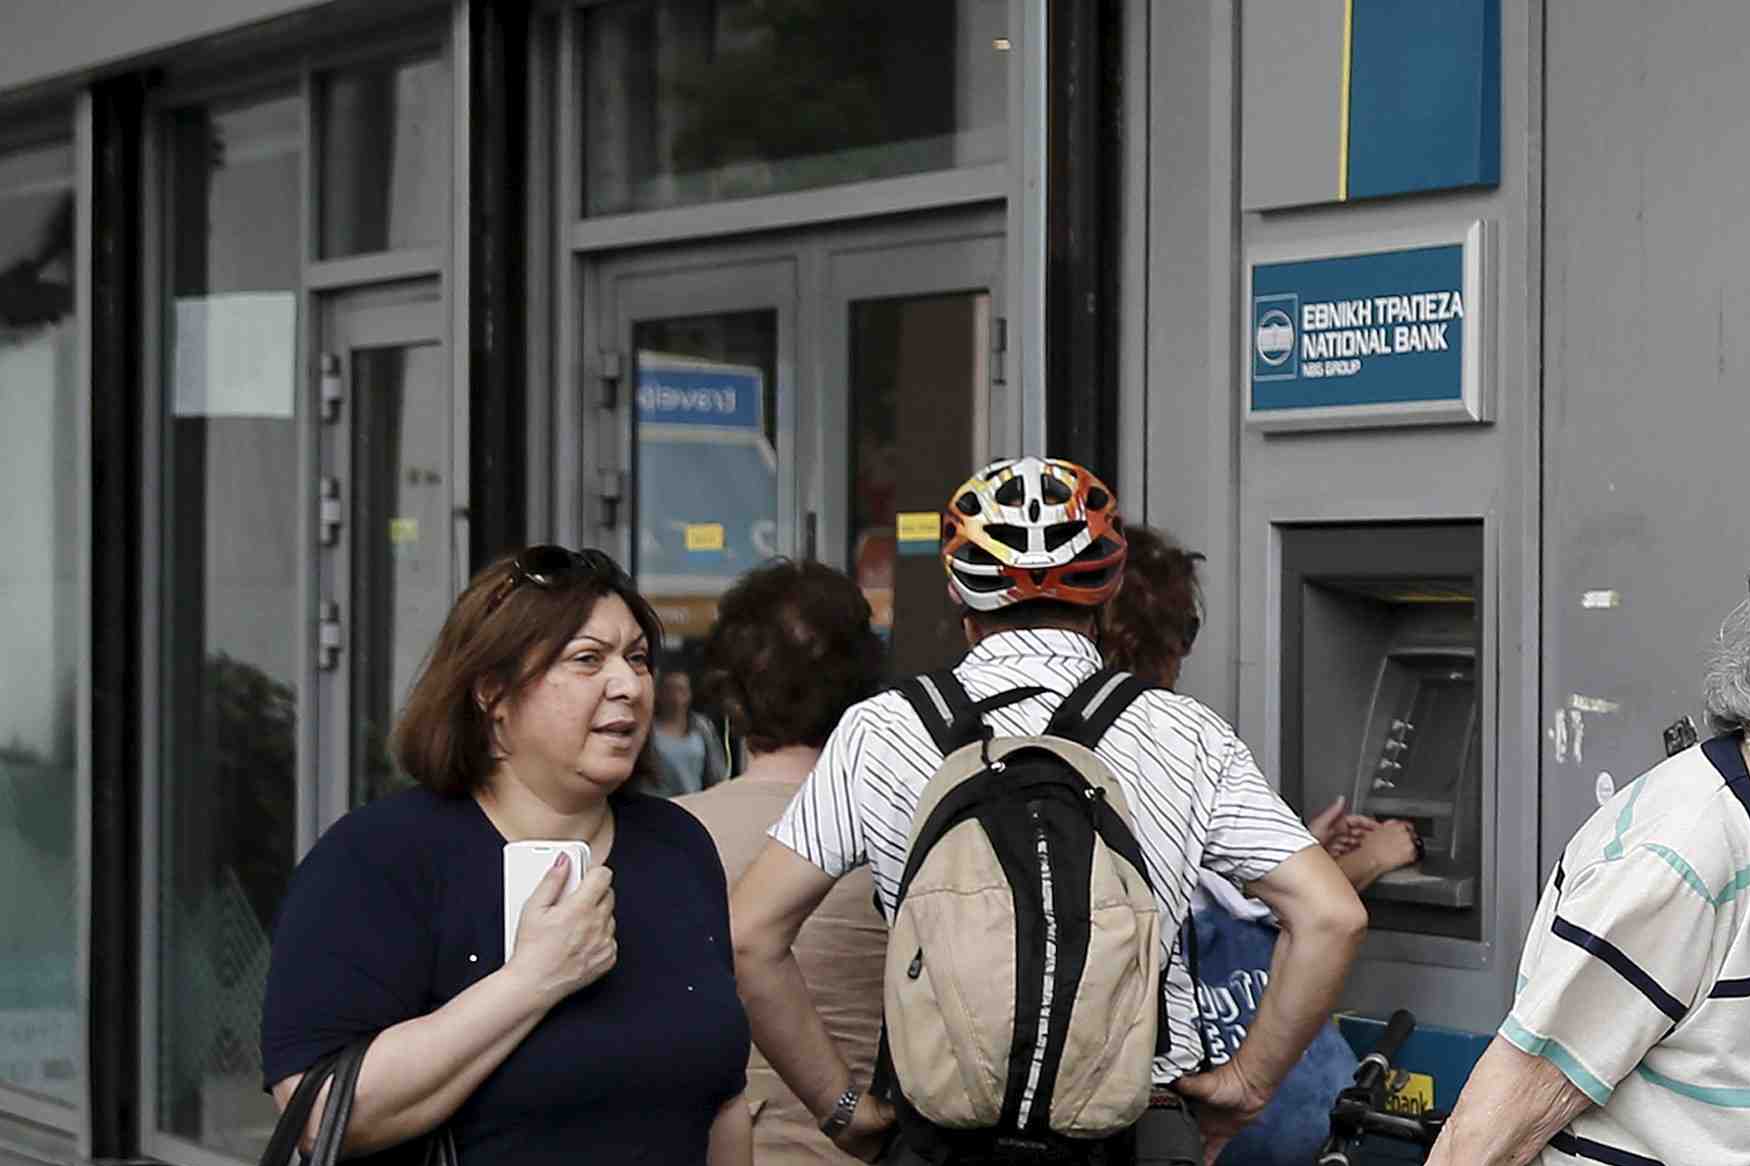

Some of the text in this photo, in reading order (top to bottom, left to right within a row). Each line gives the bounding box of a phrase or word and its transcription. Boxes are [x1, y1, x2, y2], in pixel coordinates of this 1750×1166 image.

[1302, 291, 1464, 331] ΕΘΝΙΚΗ ΤΡΑΠΕΖΑ
[1303, 324, 1448, 360] NATIONAL BANK
